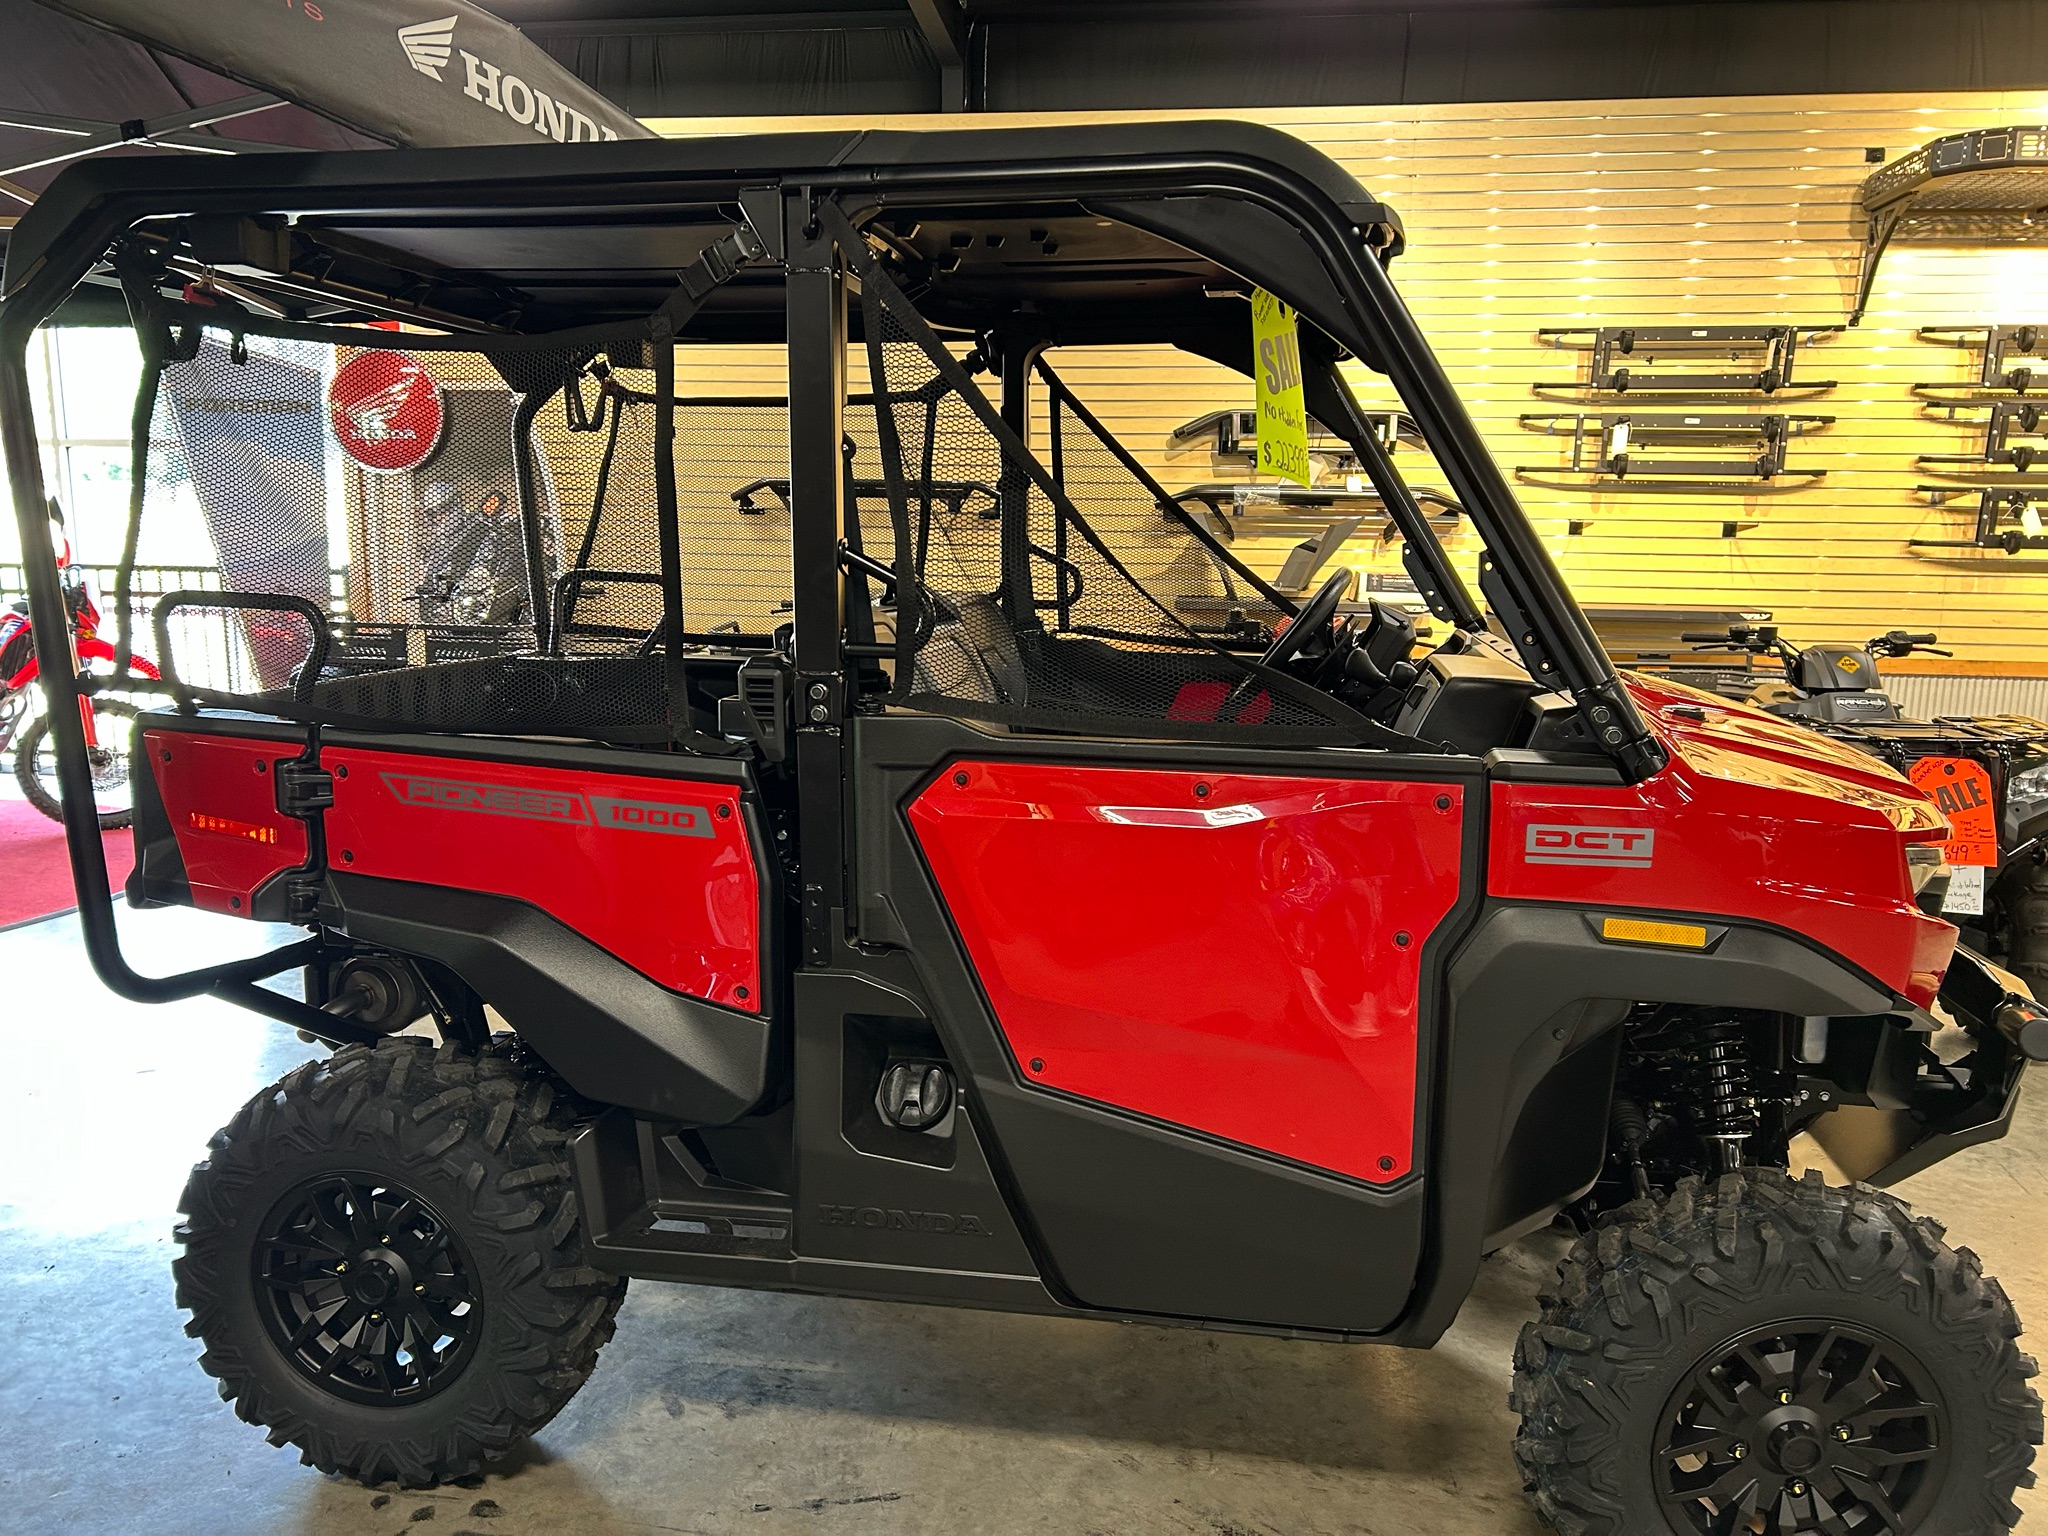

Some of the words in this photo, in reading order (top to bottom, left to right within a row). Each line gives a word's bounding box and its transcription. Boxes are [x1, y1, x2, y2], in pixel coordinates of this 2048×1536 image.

[407, 781, 572, 818] PIONEER
[611, 805, 696, 829] 1000
[1535, 829, 1646, 851] DCT
[819, 1204, 993, 1237] HONDA
